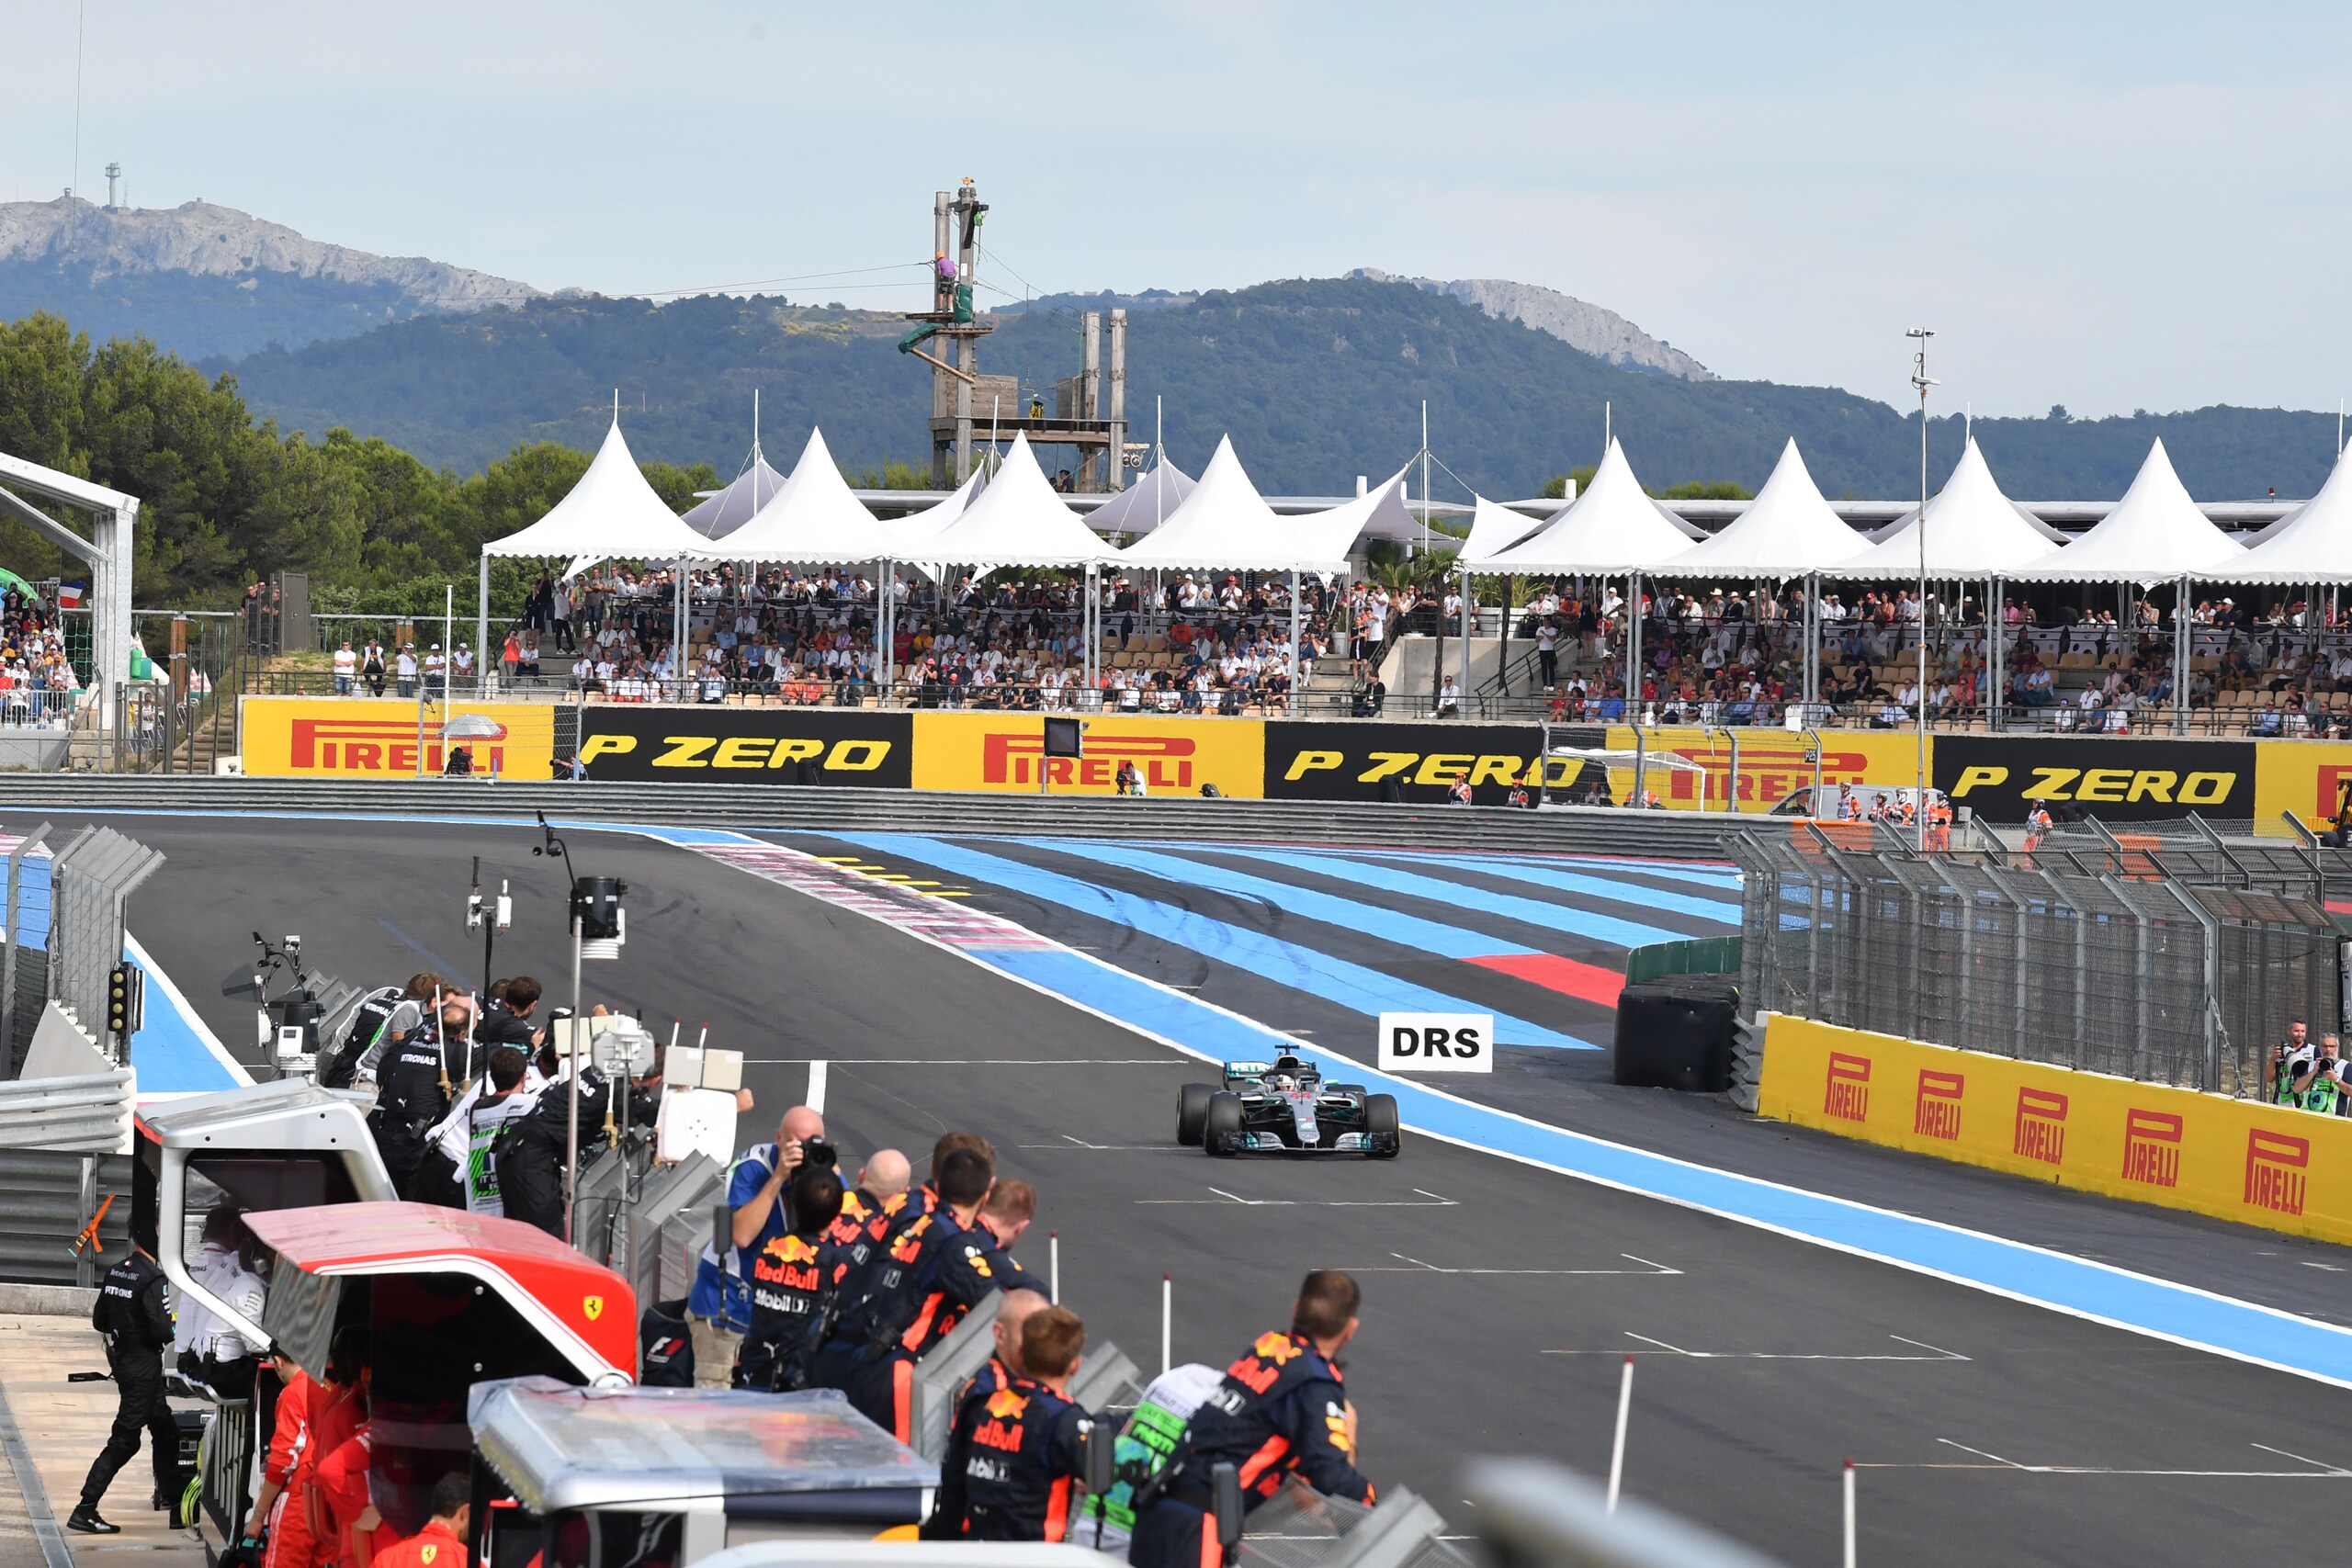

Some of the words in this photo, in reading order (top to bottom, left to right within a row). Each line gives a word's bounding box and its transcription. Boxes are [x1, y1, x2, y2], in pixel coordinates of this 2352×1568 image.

[580, 735, 638, 764] P
[652, 736, 891, 770] ZERO
[1284, 750, 1343, 780] P
[1358, 751, 1585, 787] ZERO
[1670, 749, 1867, 802] PIRE
[1951, 766, 2009, 797] P
[2022, 767, 2236, 804] ZERO
[1393, 1027, 1480, 1058] DRS
[1824, 1052, 1871, 1122] PIRELLI
[1914, 1069, 1964, 1141] PIRELLI
[2014, 1087, 2068, 1165] PIRELLI
[2122, 1109, 2183, 1188] PIRELLI
[2244, 1129, 2310, 1216] PIRELLI
[754, 1258, 786, 1284] Red
[783, 1265, 820, 1291] Bull
